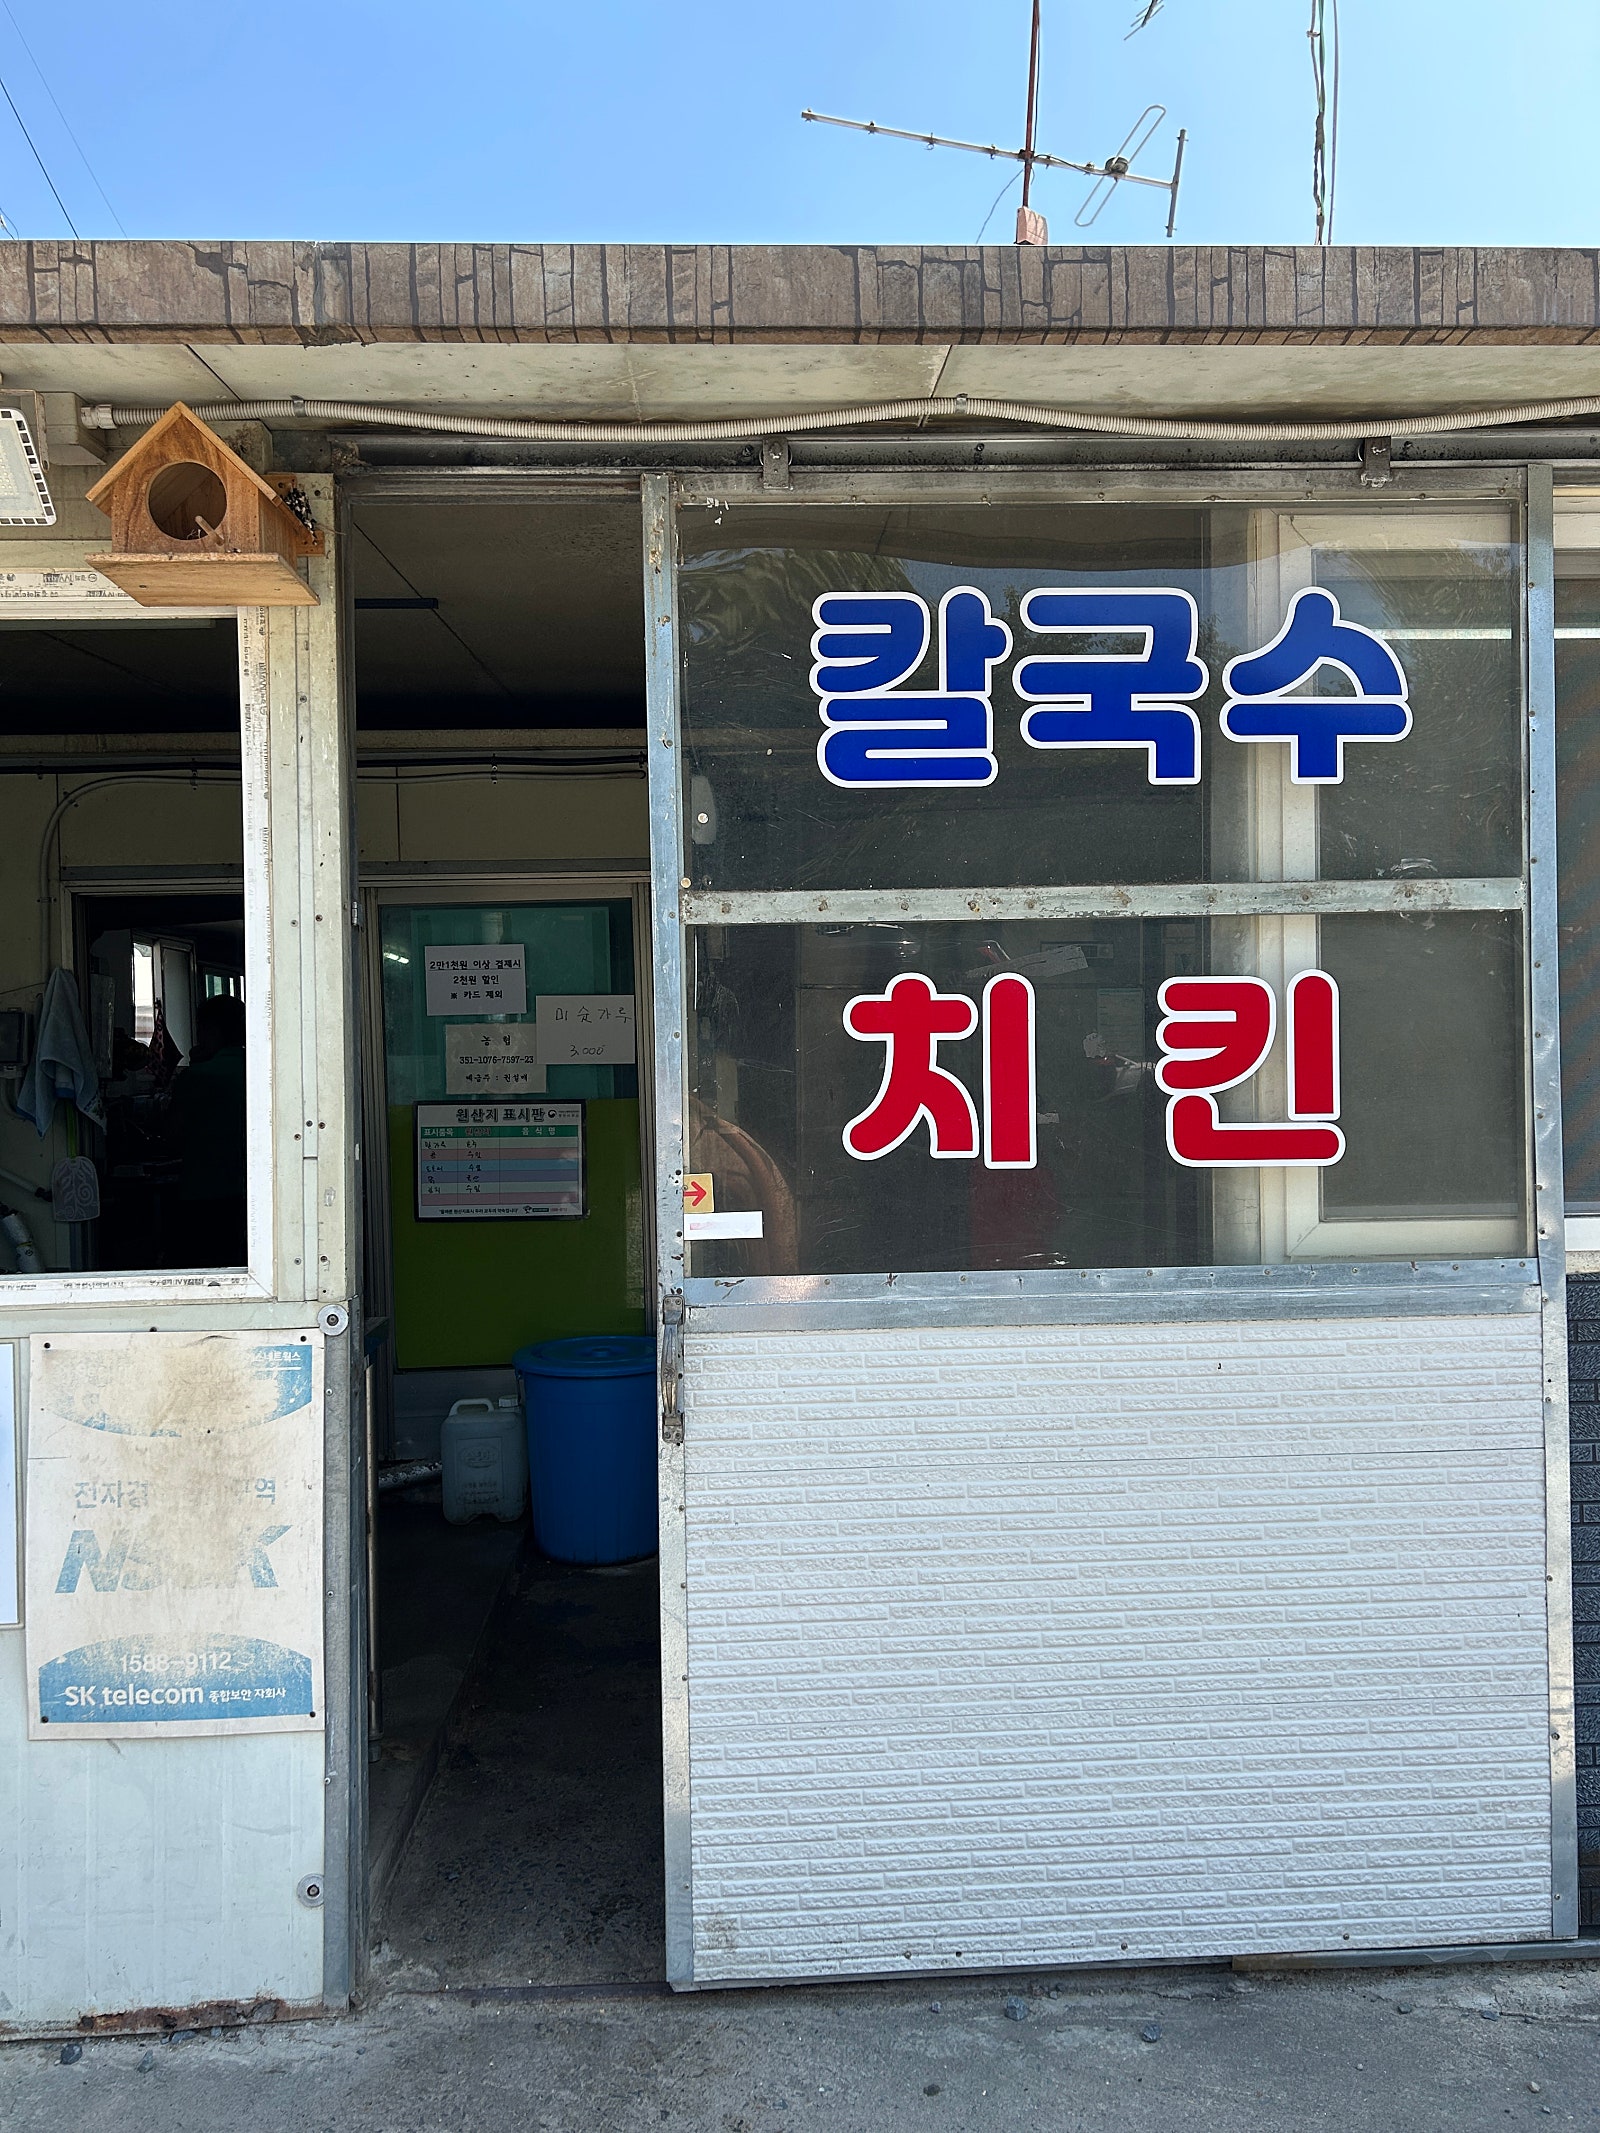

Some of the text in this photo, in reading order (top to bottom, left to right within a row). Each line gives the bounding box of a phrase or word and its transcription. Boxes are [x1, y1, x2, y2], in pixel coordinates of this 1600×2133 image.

[808, 585, 1414, 788] 칼국수
[430, 959, 521, 970] 2만1천원 이상 결제시
[453, 975, 500, 986] 2천원 할인
[463, 990, 481, 1000] 카드
[485, 990, 503, 999] 제외
[841, 969, 1347, 1171] 치킨
[456, 1107, 499, 1124] 원산지
[502, 1107, 546, 1123] 표시판
[54, 1525, 294, 1595] NSK
[120, 1651, 233, 1674] 1588-9112
[64, 1683, 287, 1707] SK telecom 종합보안 자회사
